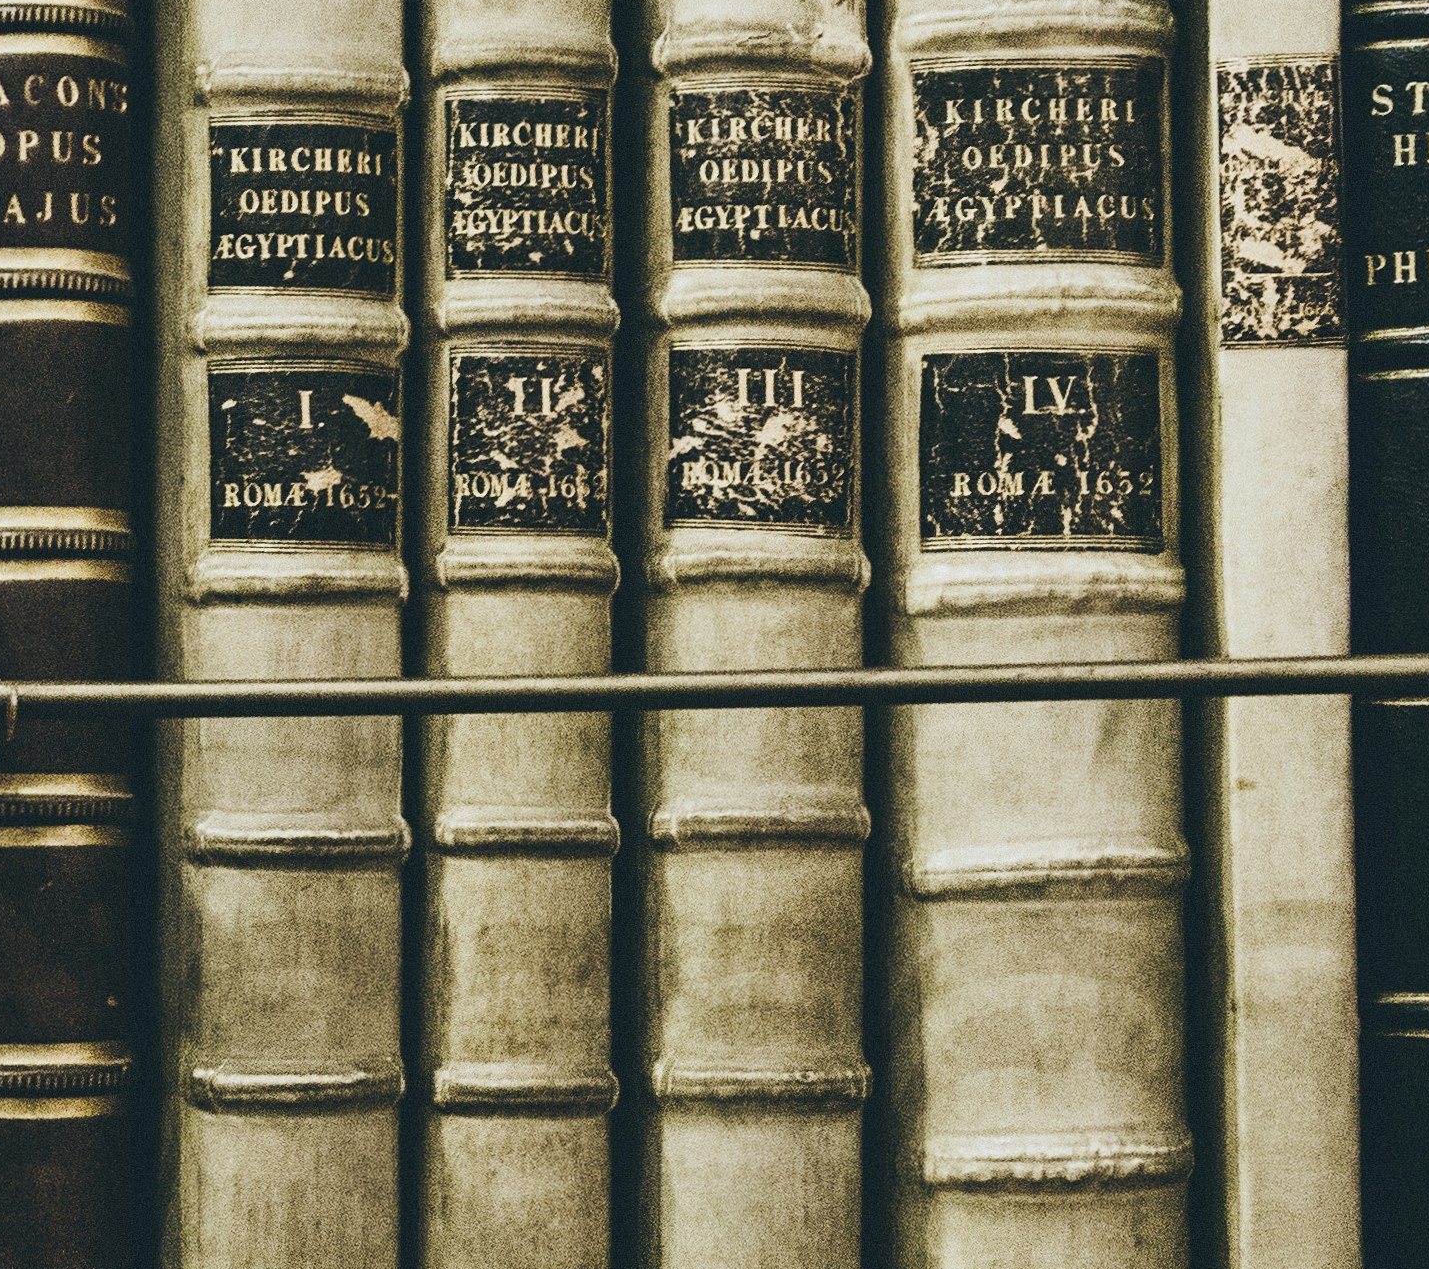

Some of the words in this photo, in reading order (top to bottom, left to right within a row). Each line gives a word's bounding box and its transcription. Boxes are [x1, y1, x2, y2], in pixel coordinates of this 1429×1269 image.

[945, 97, 1135, 124] KIRCHERI
[459, 121, 598, 151] KIRCHERI
[230, 147, 382, 176] KIRCHERI
[961, 144, 1124, 169] OEDIPUS
[472, 162, 593, 189] OEDIPUS
[699, 159, 833, 184] OEDIPUS
[239, 188, 371, 217] OEDIPUS
[926, 194, 1155, 222] ÆGYPTIACUS
[452, 209, 606, 238] ÆGYPTIACUS
[675, 205, 856, 233] ÆGYPTIACUS
[213, 232, 394, 266] ÆGYPTIACUS
[737, 368, 805, 407] III
[223, 482, 308, 507] ROMÆ
[951, 472, 1054, 497] ROMÆ
[1081, 472, 1153, 496] 1652
